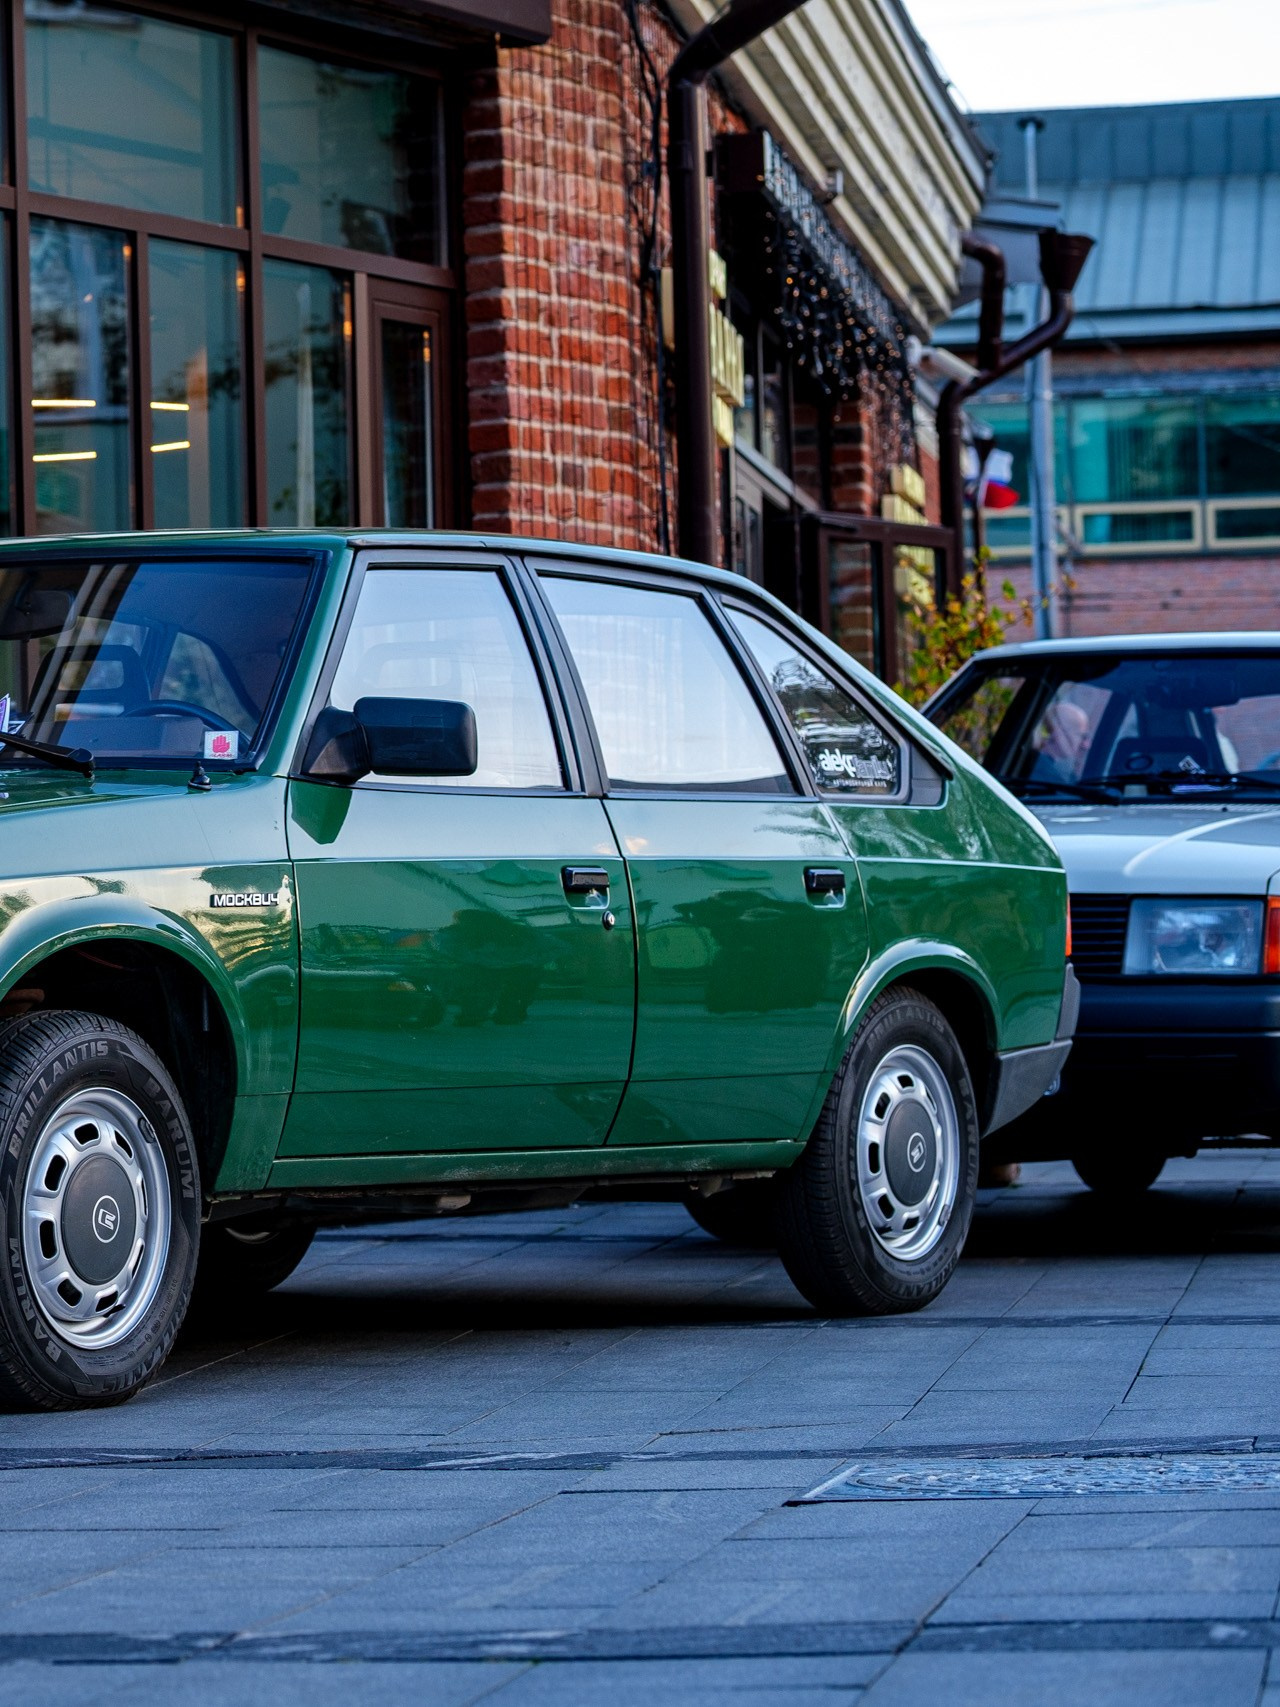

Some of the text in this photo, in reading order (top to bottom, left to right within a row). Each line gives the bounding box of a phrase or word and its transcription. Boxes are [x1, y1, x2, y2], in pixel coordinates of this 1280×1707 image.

[8, 1041, 109, 1160] BRILLANTIS
[143, 1076, 195, 1199] BARUM
[9, 1237, 62, 1363] BARUM
